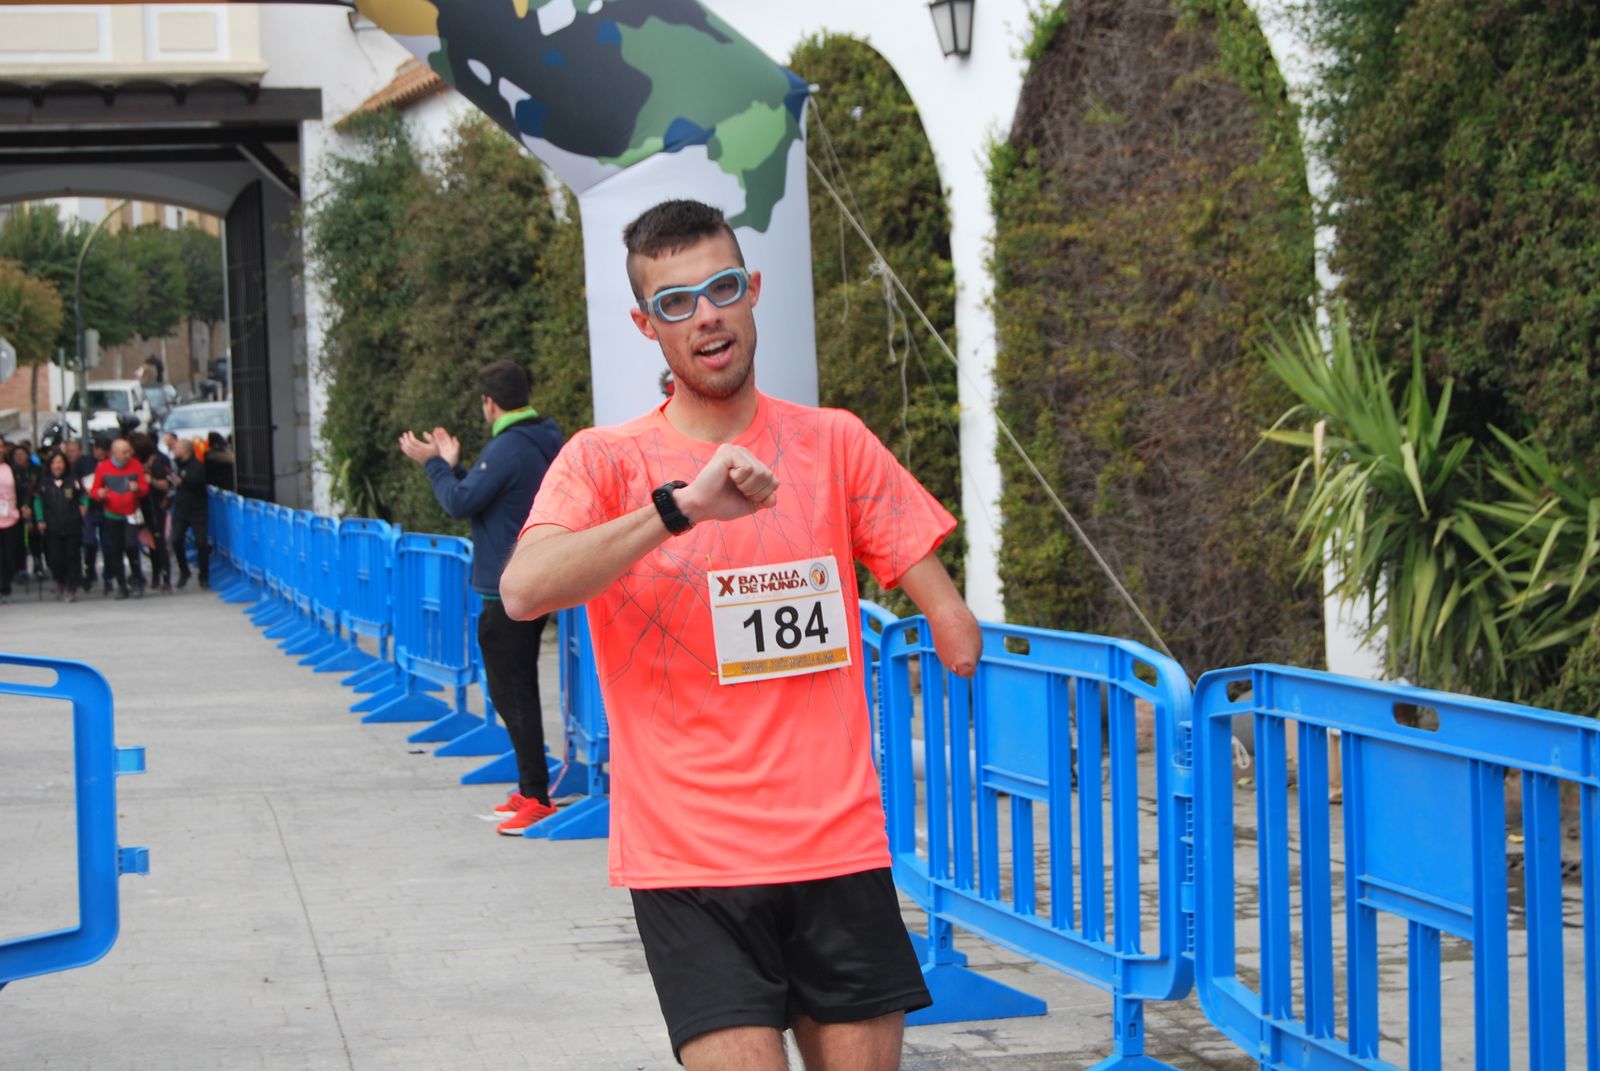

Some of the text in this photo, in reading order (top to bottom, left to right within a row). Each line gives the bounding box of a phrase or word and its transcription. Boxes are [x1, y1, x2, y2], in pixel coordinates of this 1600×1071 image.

[716, 575, 735, 597] X
[738, 569, 799, 585] BATALLA
[739, 578, 808, 595] DE MUNDA
[743, 601, 828, 653] 184
